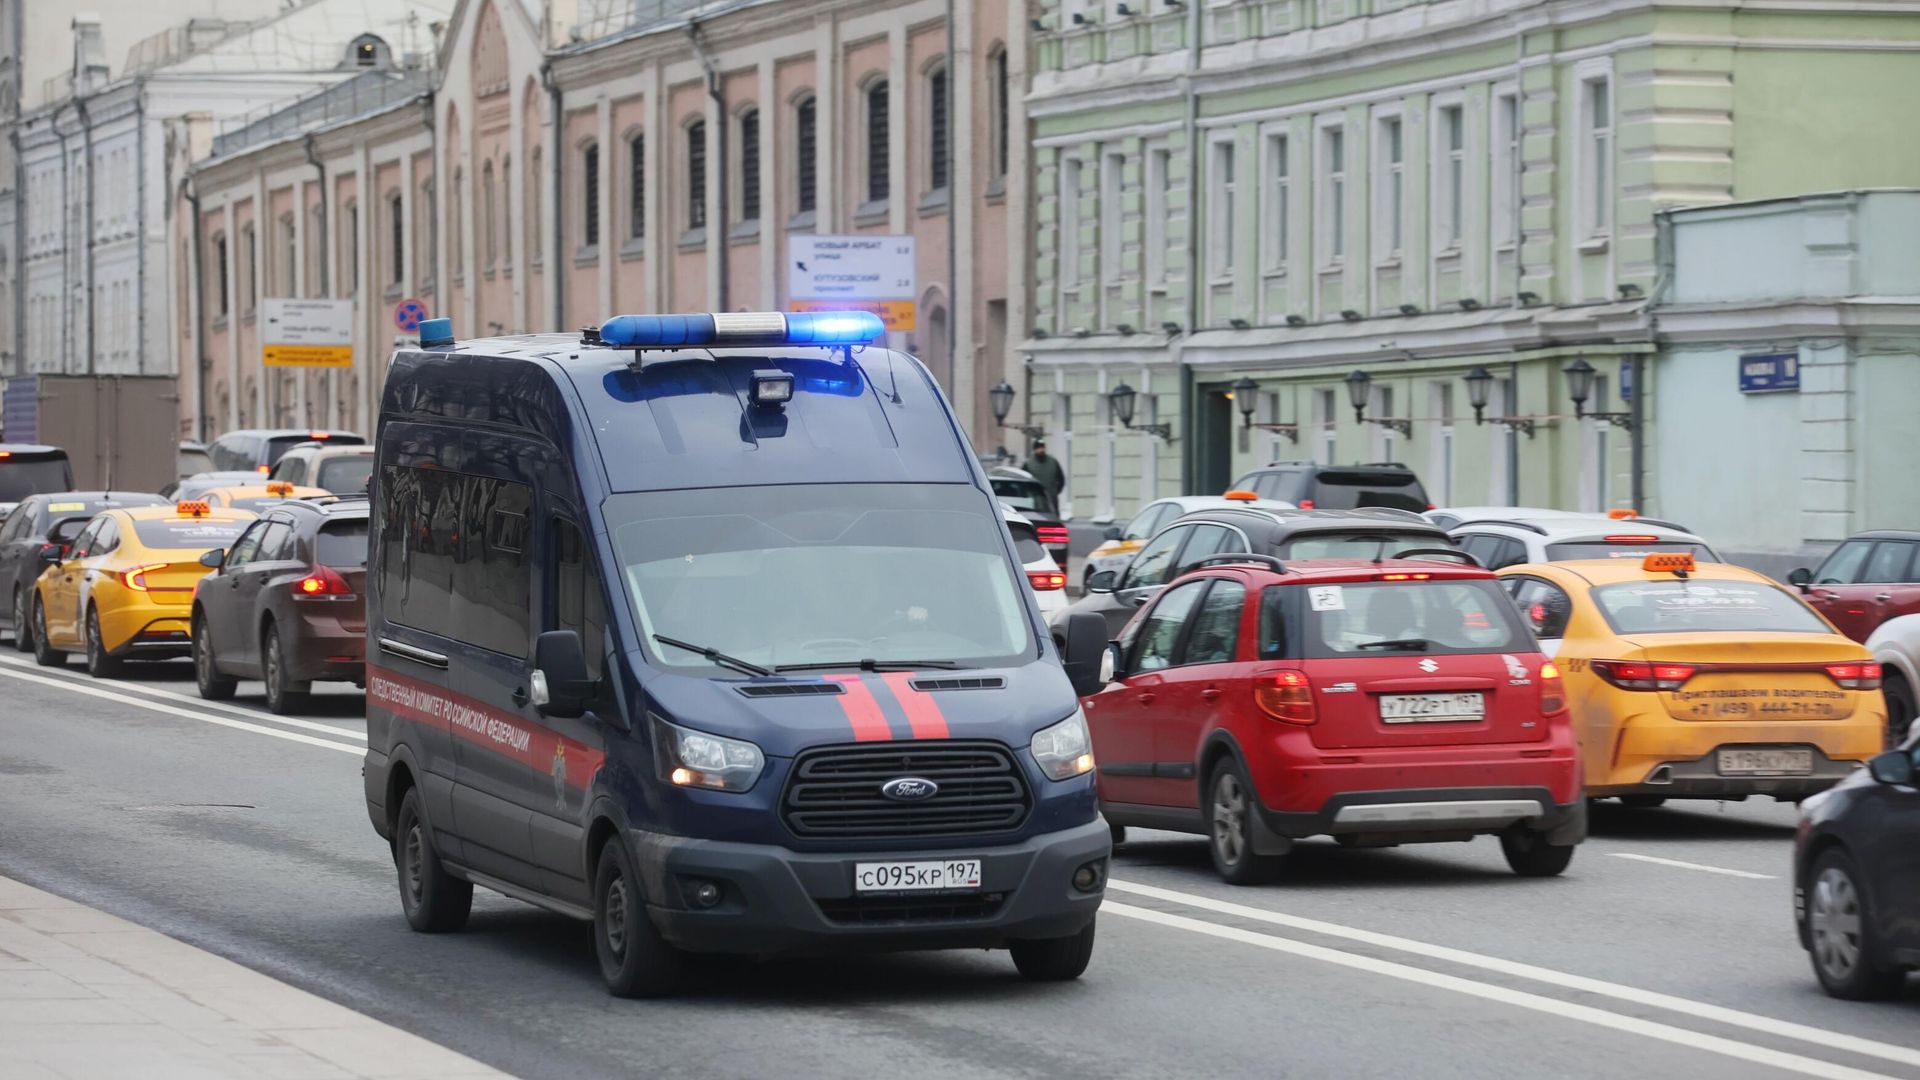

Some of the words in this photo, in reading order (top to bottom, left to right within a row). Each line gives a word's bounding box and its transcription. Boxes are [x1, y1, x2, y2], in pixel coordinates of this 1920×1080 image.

[813, 240, 850, 249] НОВЫЙ
[852, 240, 882, 249] АРБАТ
[813, 274, 880, 282] КУТУЗОВСКИЙ
[371, 676, 417, 708] СЛЕДСТВЕННЫЙ
[415, 689, 444, 717] КОМИТЕТ
[442, 700, 488, 735] РОССИЙСКОЙ
[487, 717, 531, 752] ФЕДЕРАЦИИ
[896, 782, 926, 796] Ford
[862, 865, 942, 887] С095КР
[947, 862, 976, 878] 197
